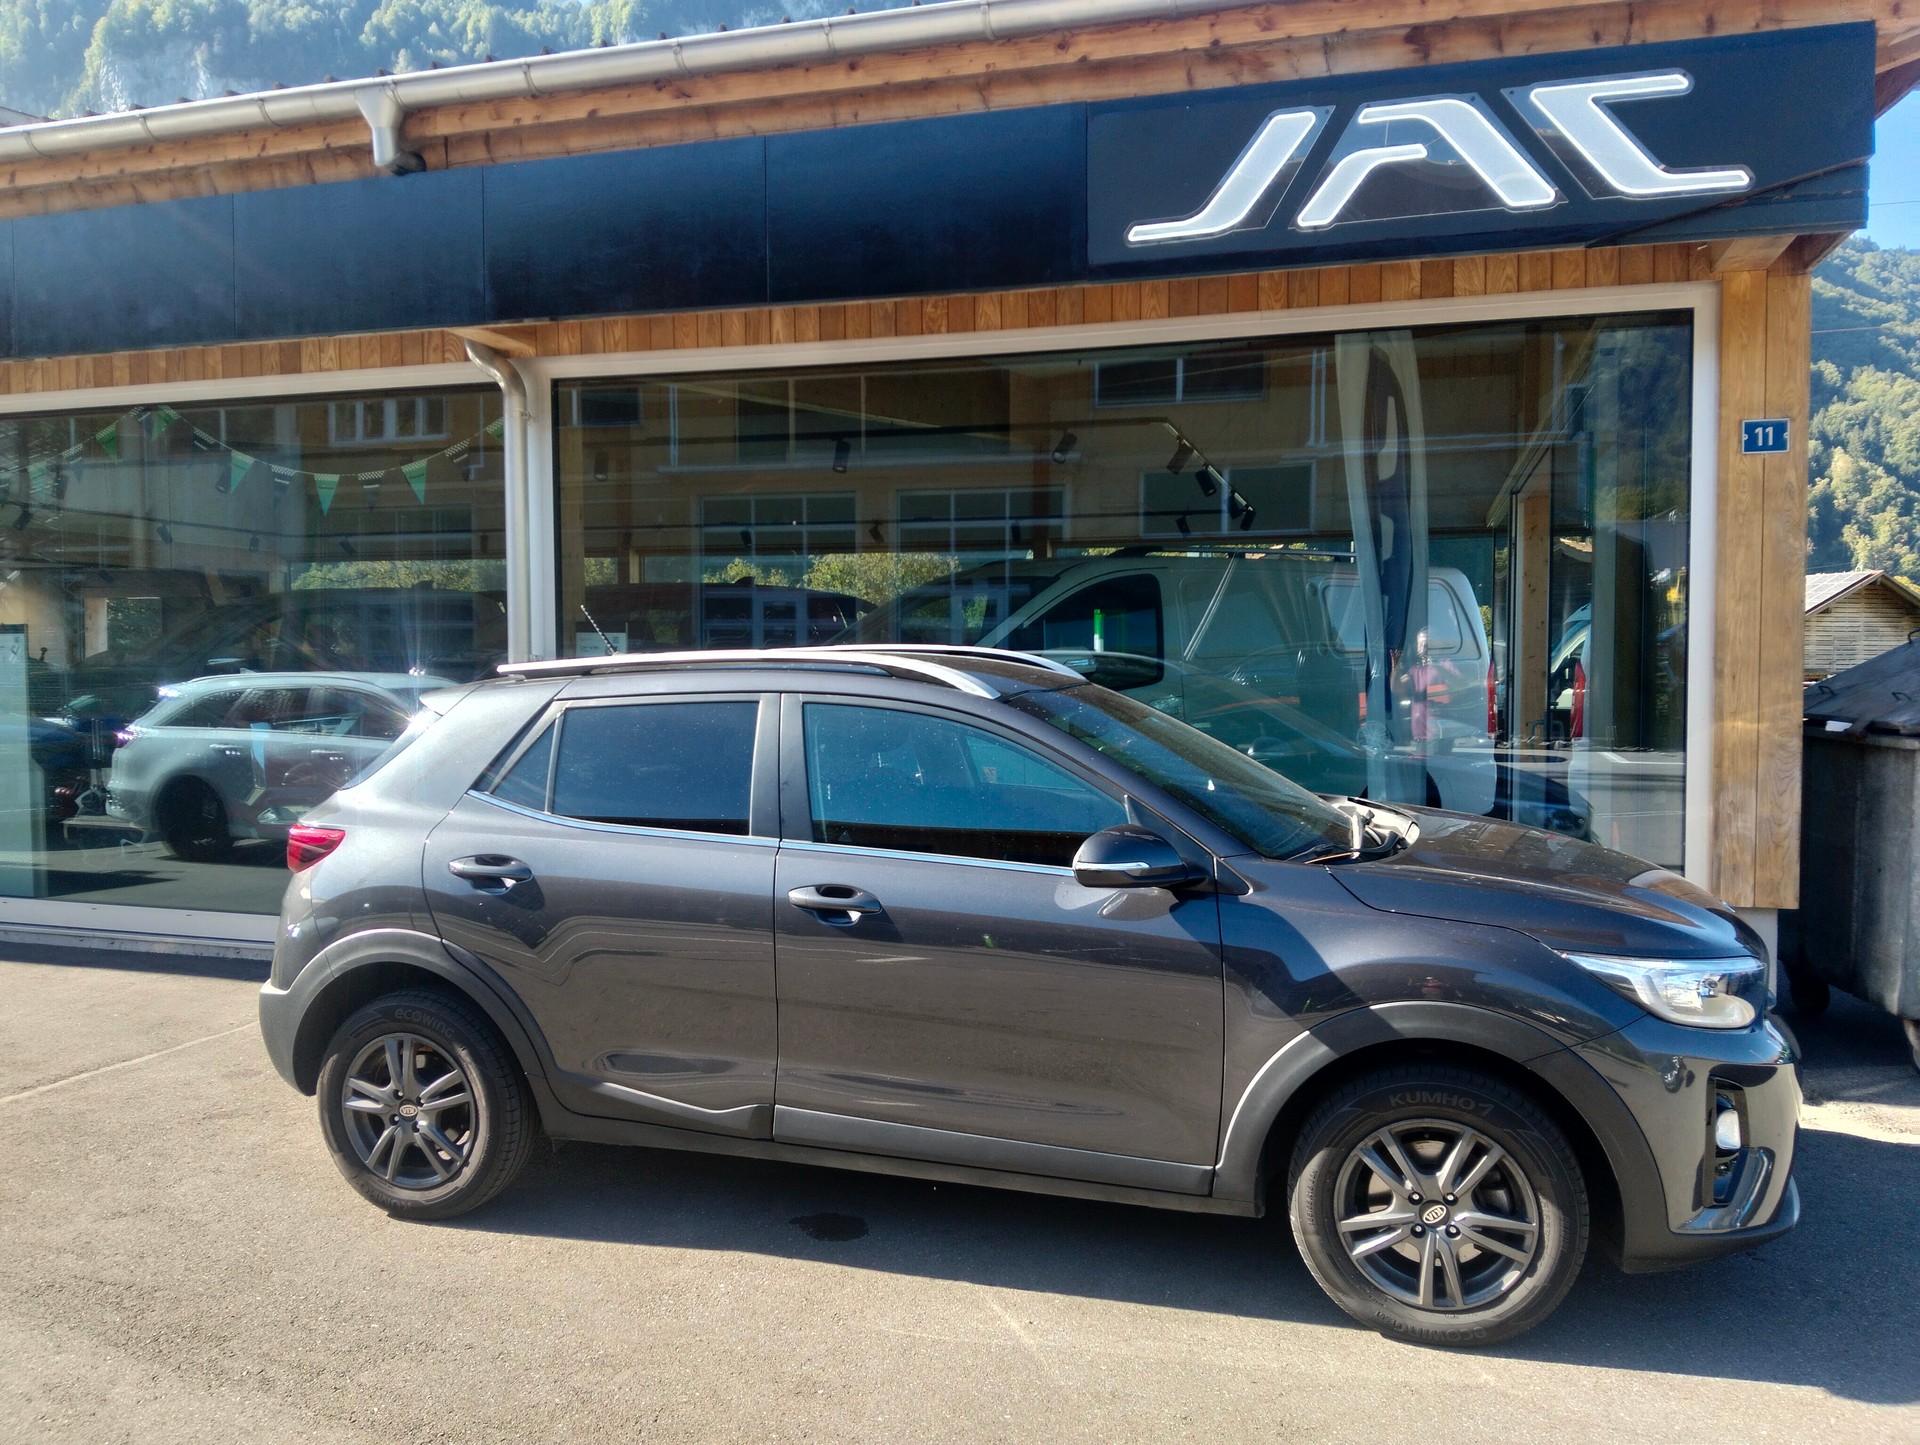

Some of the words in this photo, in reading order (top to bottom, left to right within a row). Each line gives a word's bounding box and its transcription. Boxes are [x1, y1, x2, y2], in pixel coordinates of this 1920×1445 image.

[1125, 72, 1753, 244] JAC
[1754, 426, 1774, 447] 11
[1389, 1091, 1476, 1111] KUMHO
[1424, 1206, 1446, 1223] KIA
